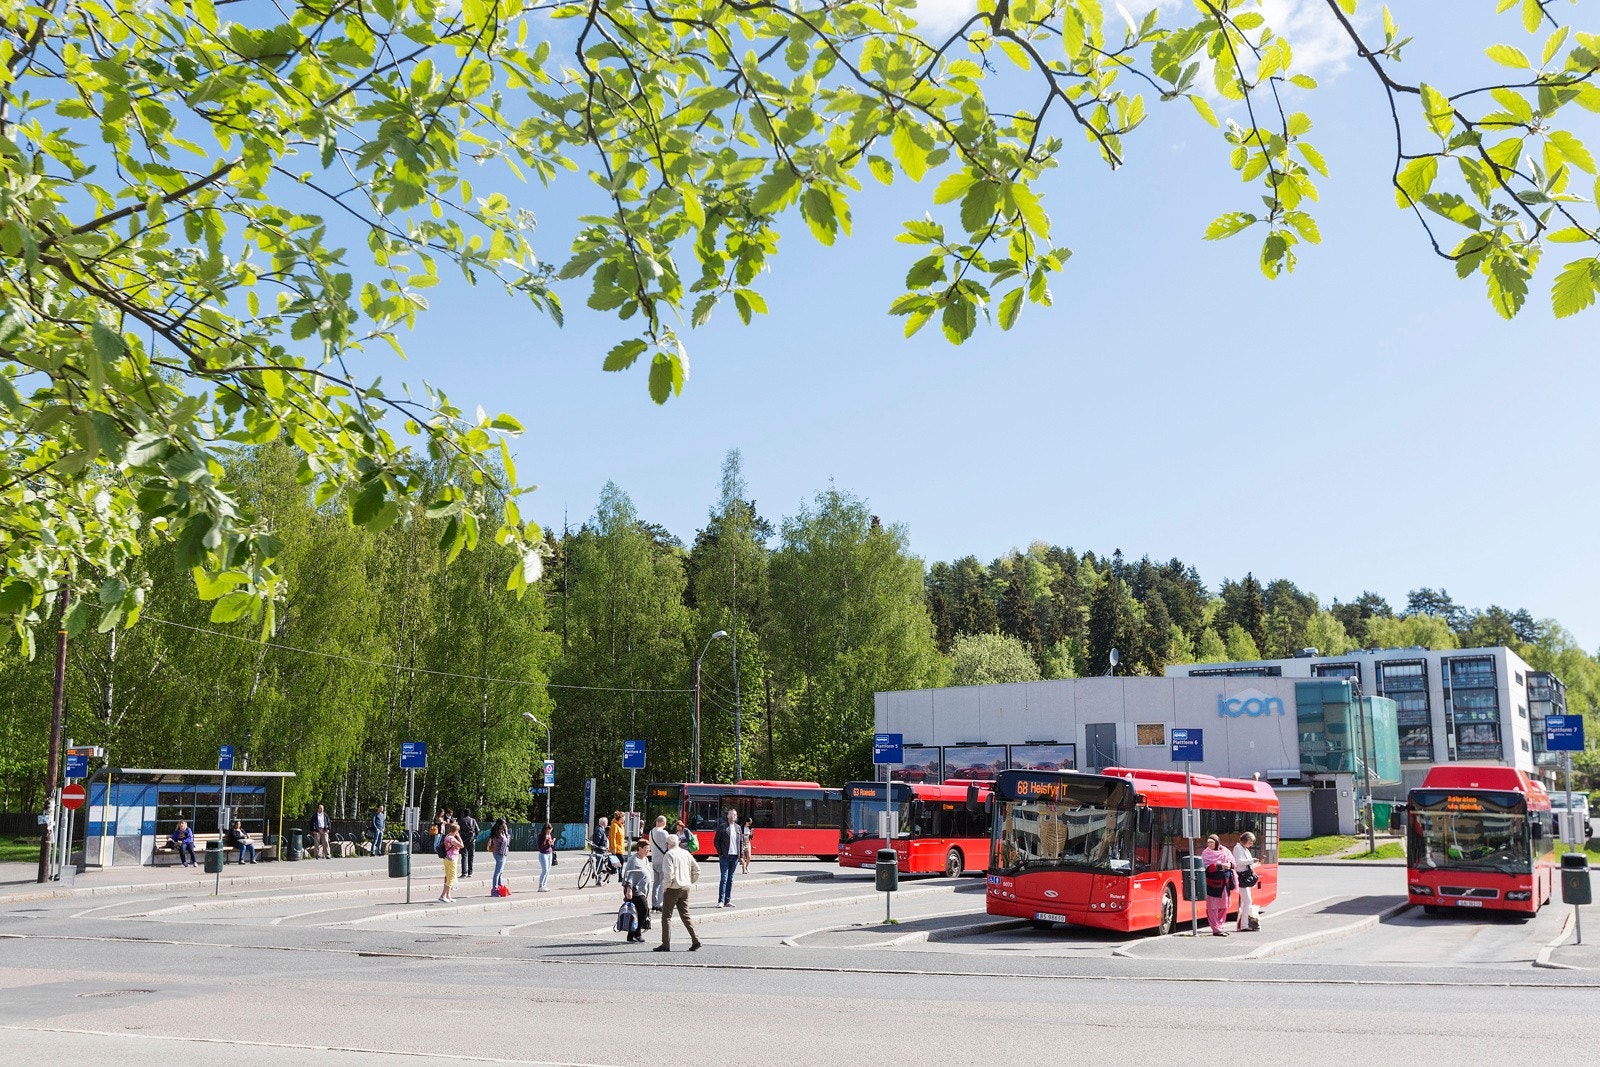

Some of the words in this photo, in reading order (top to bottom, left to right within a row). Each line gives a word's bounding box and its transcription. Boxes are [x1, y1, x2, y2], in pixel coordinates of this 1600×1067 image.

[1217, 694, 1285, 718] icon
[1017, 780, 1028, 795] 68
[1030, 782, 1059, 797] Helsfyr
